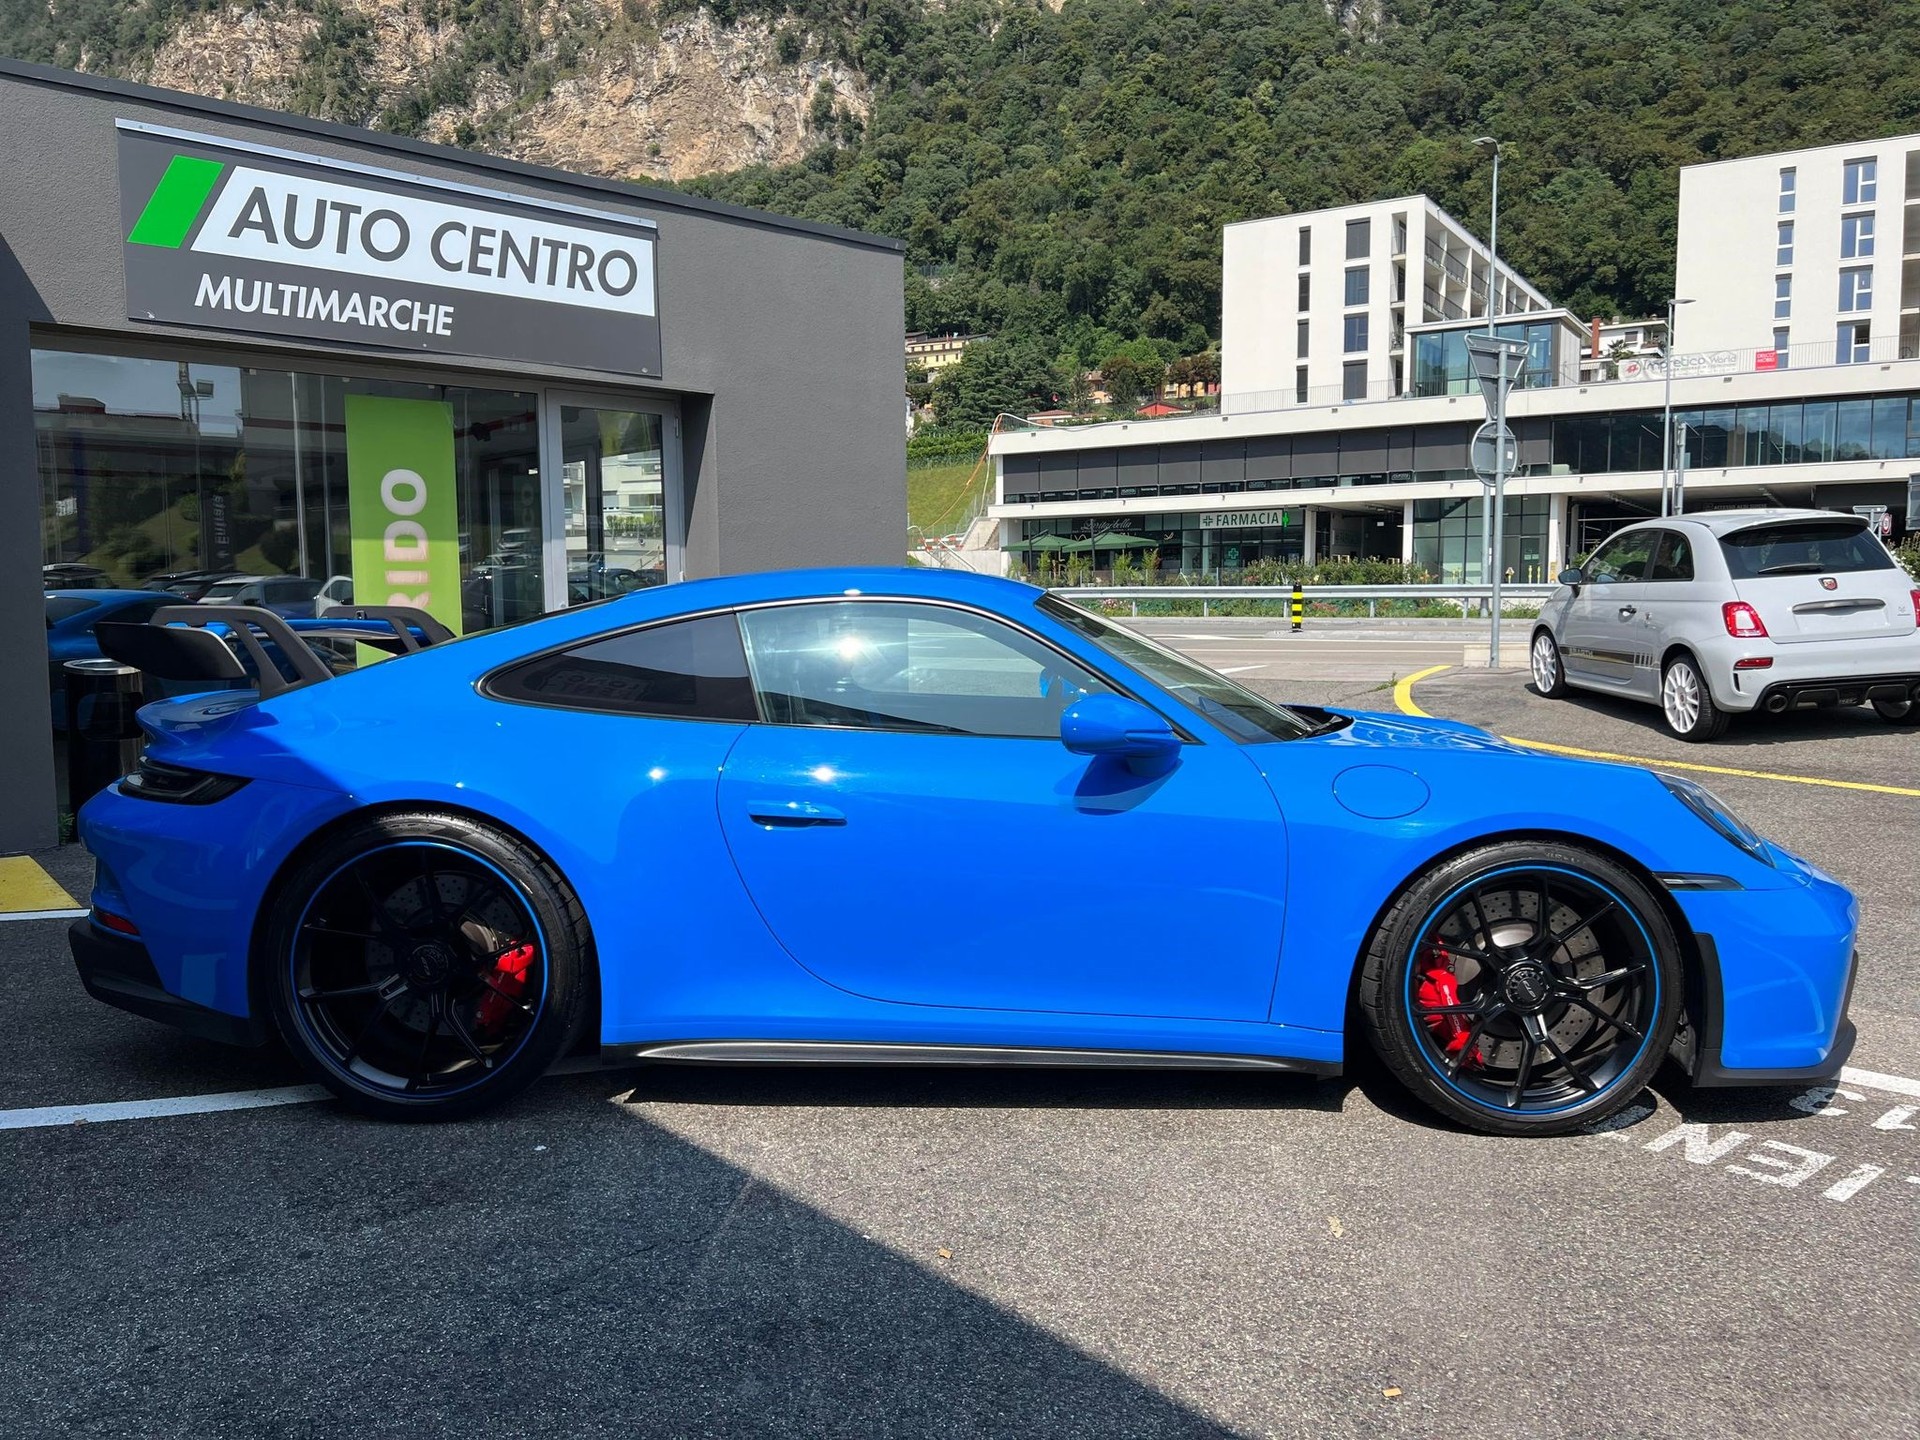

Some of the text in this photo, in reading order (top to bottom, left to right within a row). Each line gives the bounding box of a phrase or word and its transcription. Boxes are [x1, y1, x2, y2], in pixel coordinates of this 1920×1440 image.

[227, 186, 638, 297] AUTO CENTRO
[194, 274, 455, 336] MULTIMARCHE
[1216, 511, 1279, 527] FARMACIA
